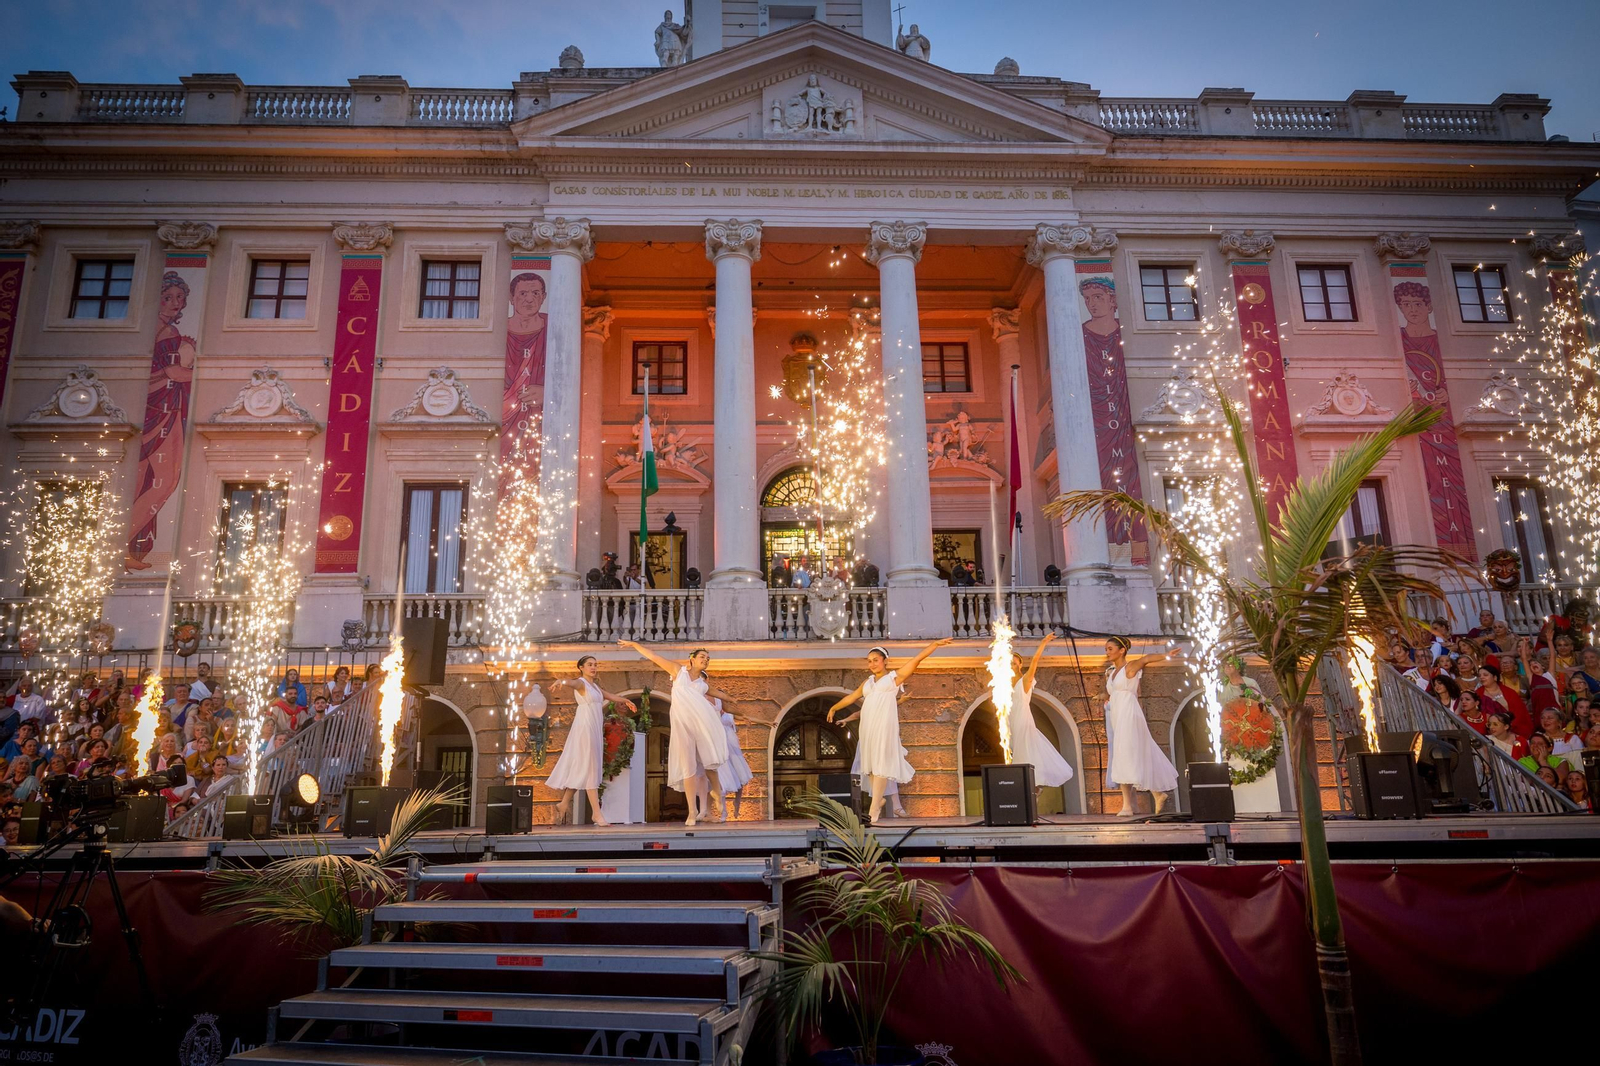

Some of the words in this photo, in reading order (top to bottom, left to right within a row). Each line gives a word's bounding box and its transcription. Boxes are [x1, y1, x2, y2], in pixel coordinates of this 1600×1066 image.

[681, 187, 696, 196] DE
[701, 187, 717, 197] LA
[723, 188, 741, 197] MUI
[746, 188, 779, 198] NOBLE
[908, 188, 952, 199] CIUDAD
[955, 190, 969, 199] DE
[1007, 188, 1030, 200] AÑO
[1034, 190, 1048, 200] DE
[145, 353, 180, 541] TELETUSA
[334, 316, 367, 493] CÁDIZ
[516, 348, 532, 431] BALBO
[1101, 350, 1120, 430] BALBO
[1111, 447, 1131, 531] MENR
[1252, 321, 1290, 492] ROMANA
[1421, 370, 1459, 532] COUMELA
[42, 1052, 55, 1063] DE
